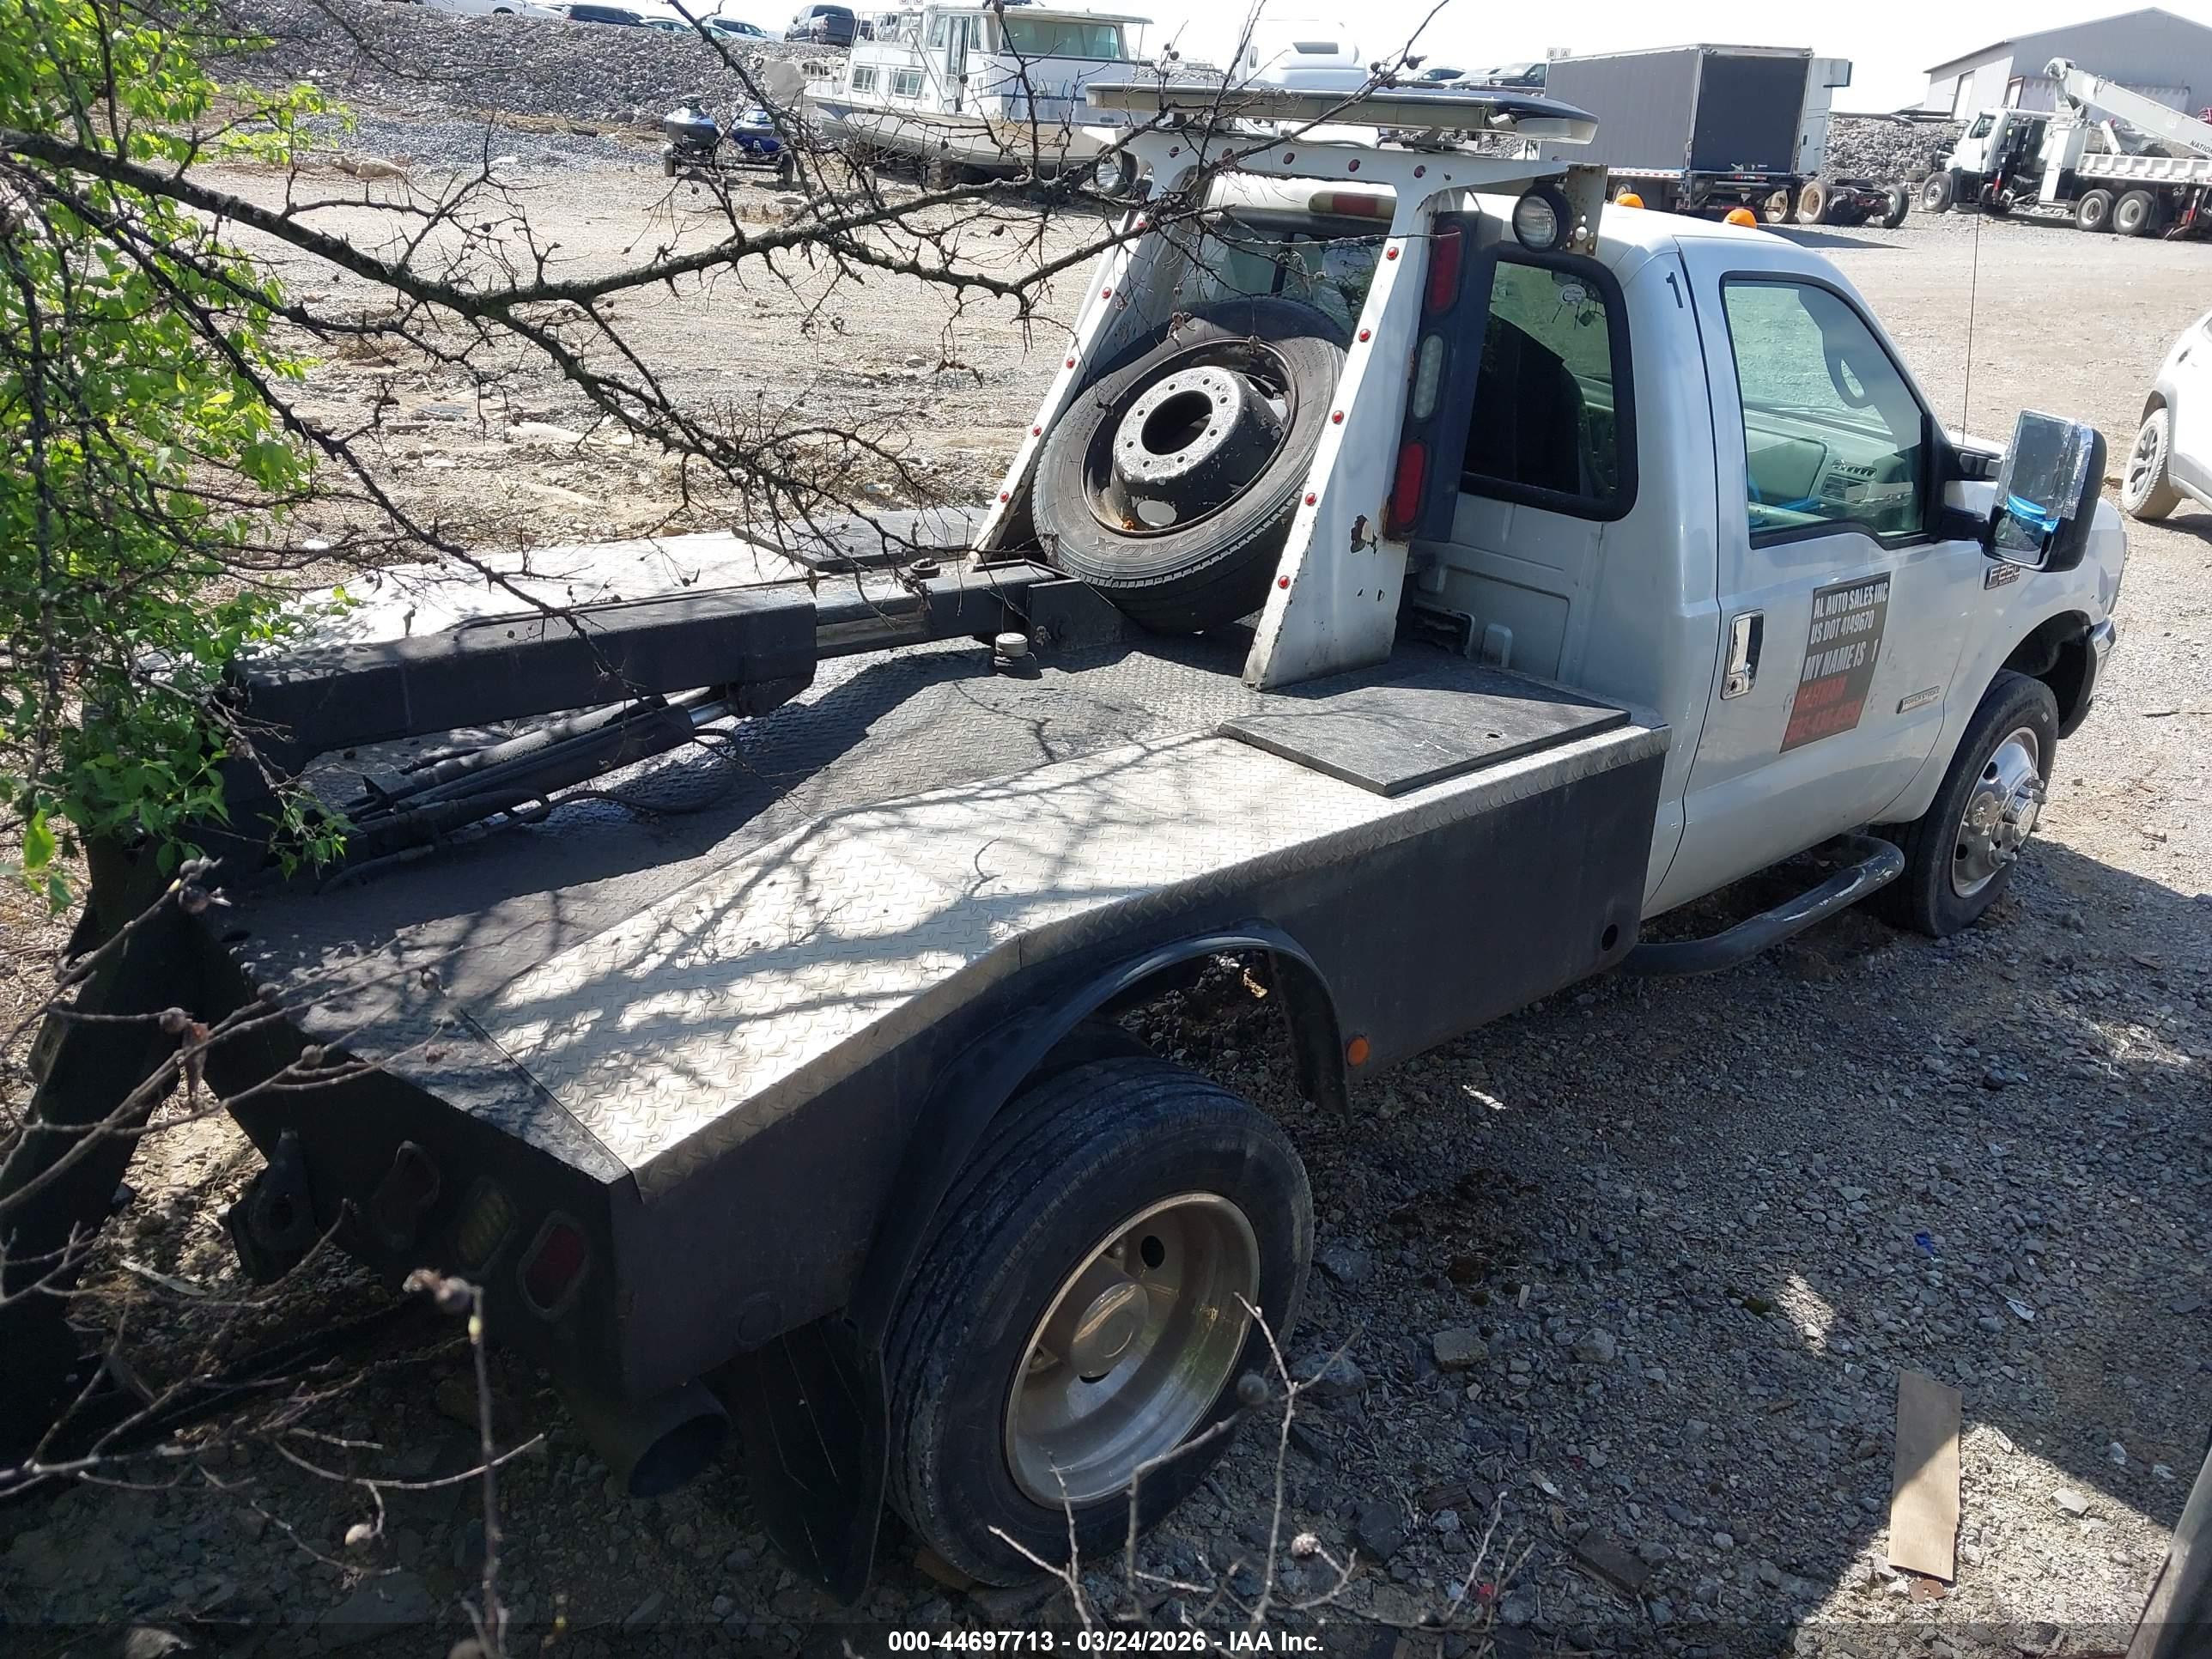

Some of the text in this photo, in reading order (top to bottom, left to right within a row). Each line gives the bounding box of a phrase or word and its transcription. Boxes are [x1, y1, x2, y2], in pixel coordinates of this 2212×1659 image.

[1666, 271, 1684, 308] 1
[1814, 582, 1889, 619] AL AUTO SALES INC
[1810, 610, 1875, 644] US DOT 4149670
[1802, 639, 1879, 682] MY NAME IS 1
